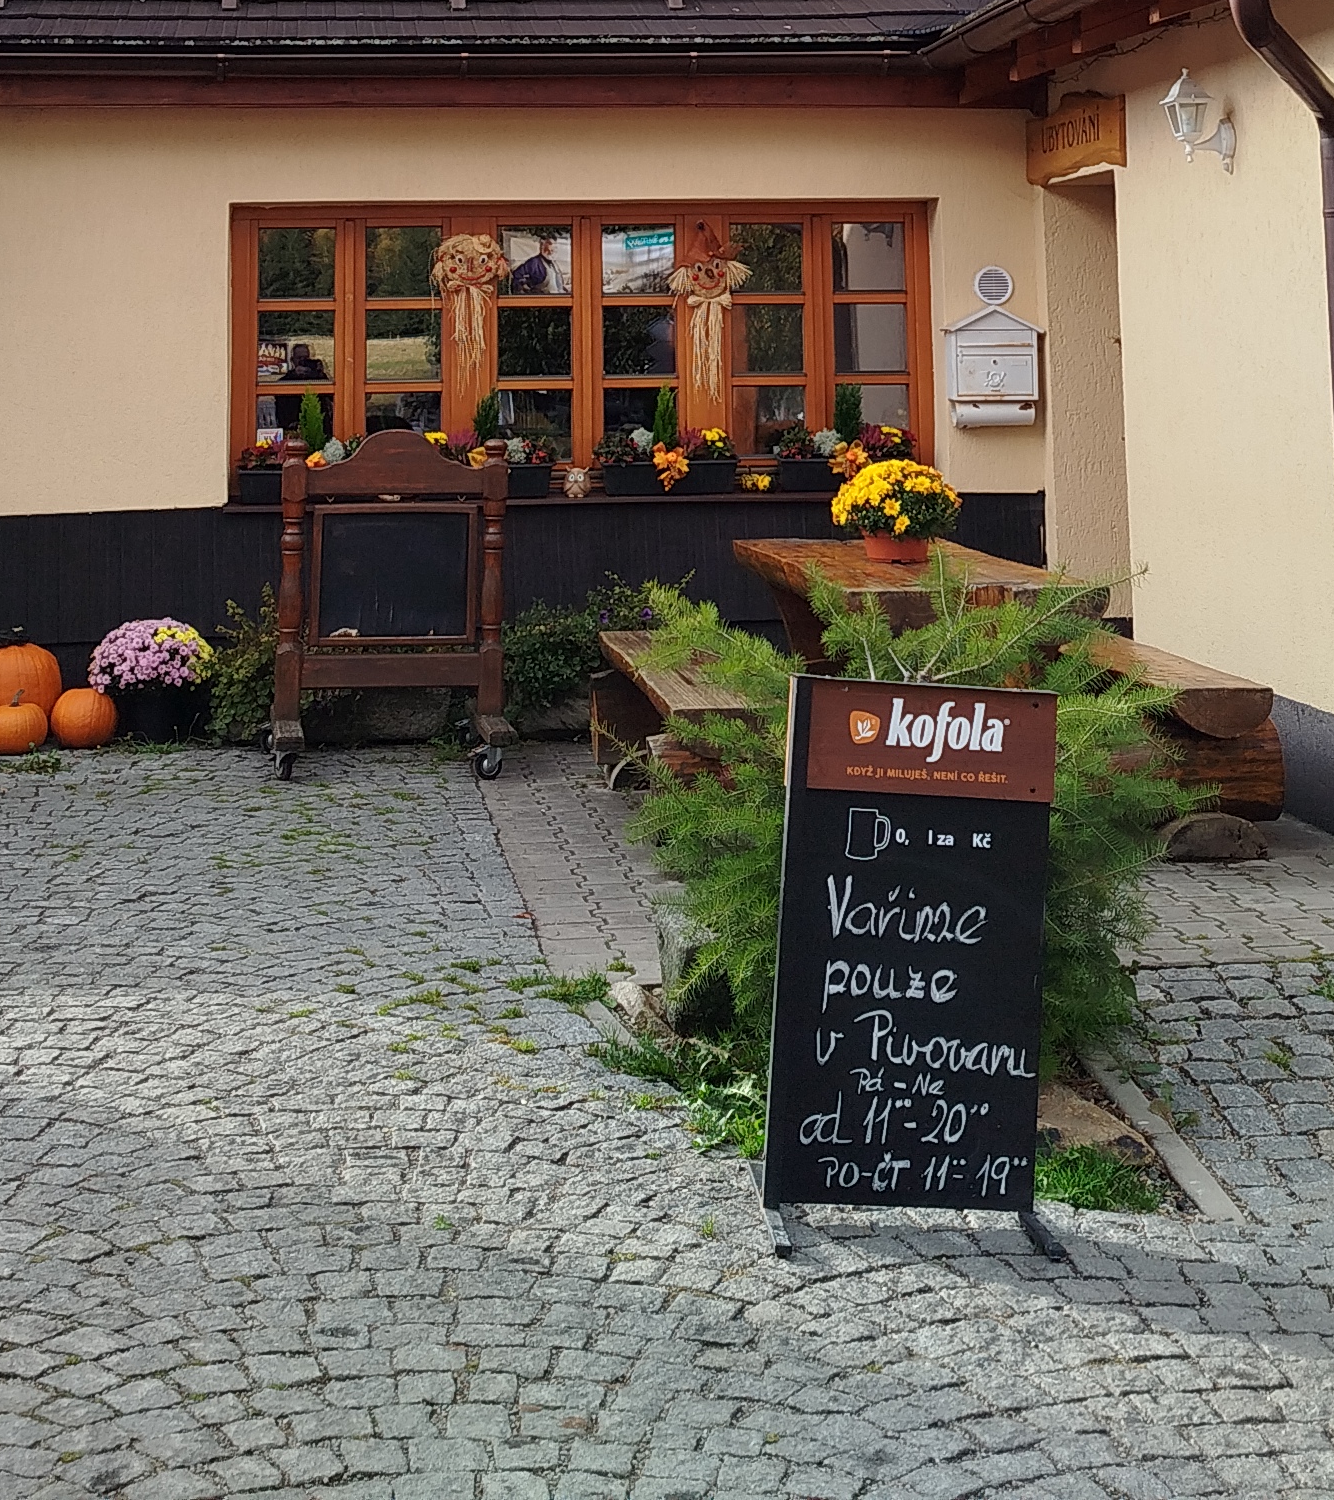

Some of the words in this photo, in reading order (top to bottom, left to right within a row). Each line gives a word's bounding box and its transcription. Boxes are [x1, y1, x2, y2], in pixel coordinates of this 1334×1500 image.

[1041, 103, 1101, 154] UBYTOVÁNÍ
[885, 697, 1005, 763] kofola
[846, 765, 874, 777] KDYŽ
[875, 767, 884, 779] JI
[933, 770, 958, 781] NENÍ
[960, 772, 976, 782] CO
[978, 771, 1009, 784] ŘEŠIT.
[894, 828, 910, 846] 0,
[936, 833, 955, 847] za
[972, 832, 993, 849] Kč
[821, 959, 959, 1014] pouze
[853, 1008, 1037, 1079] Pivovaru
